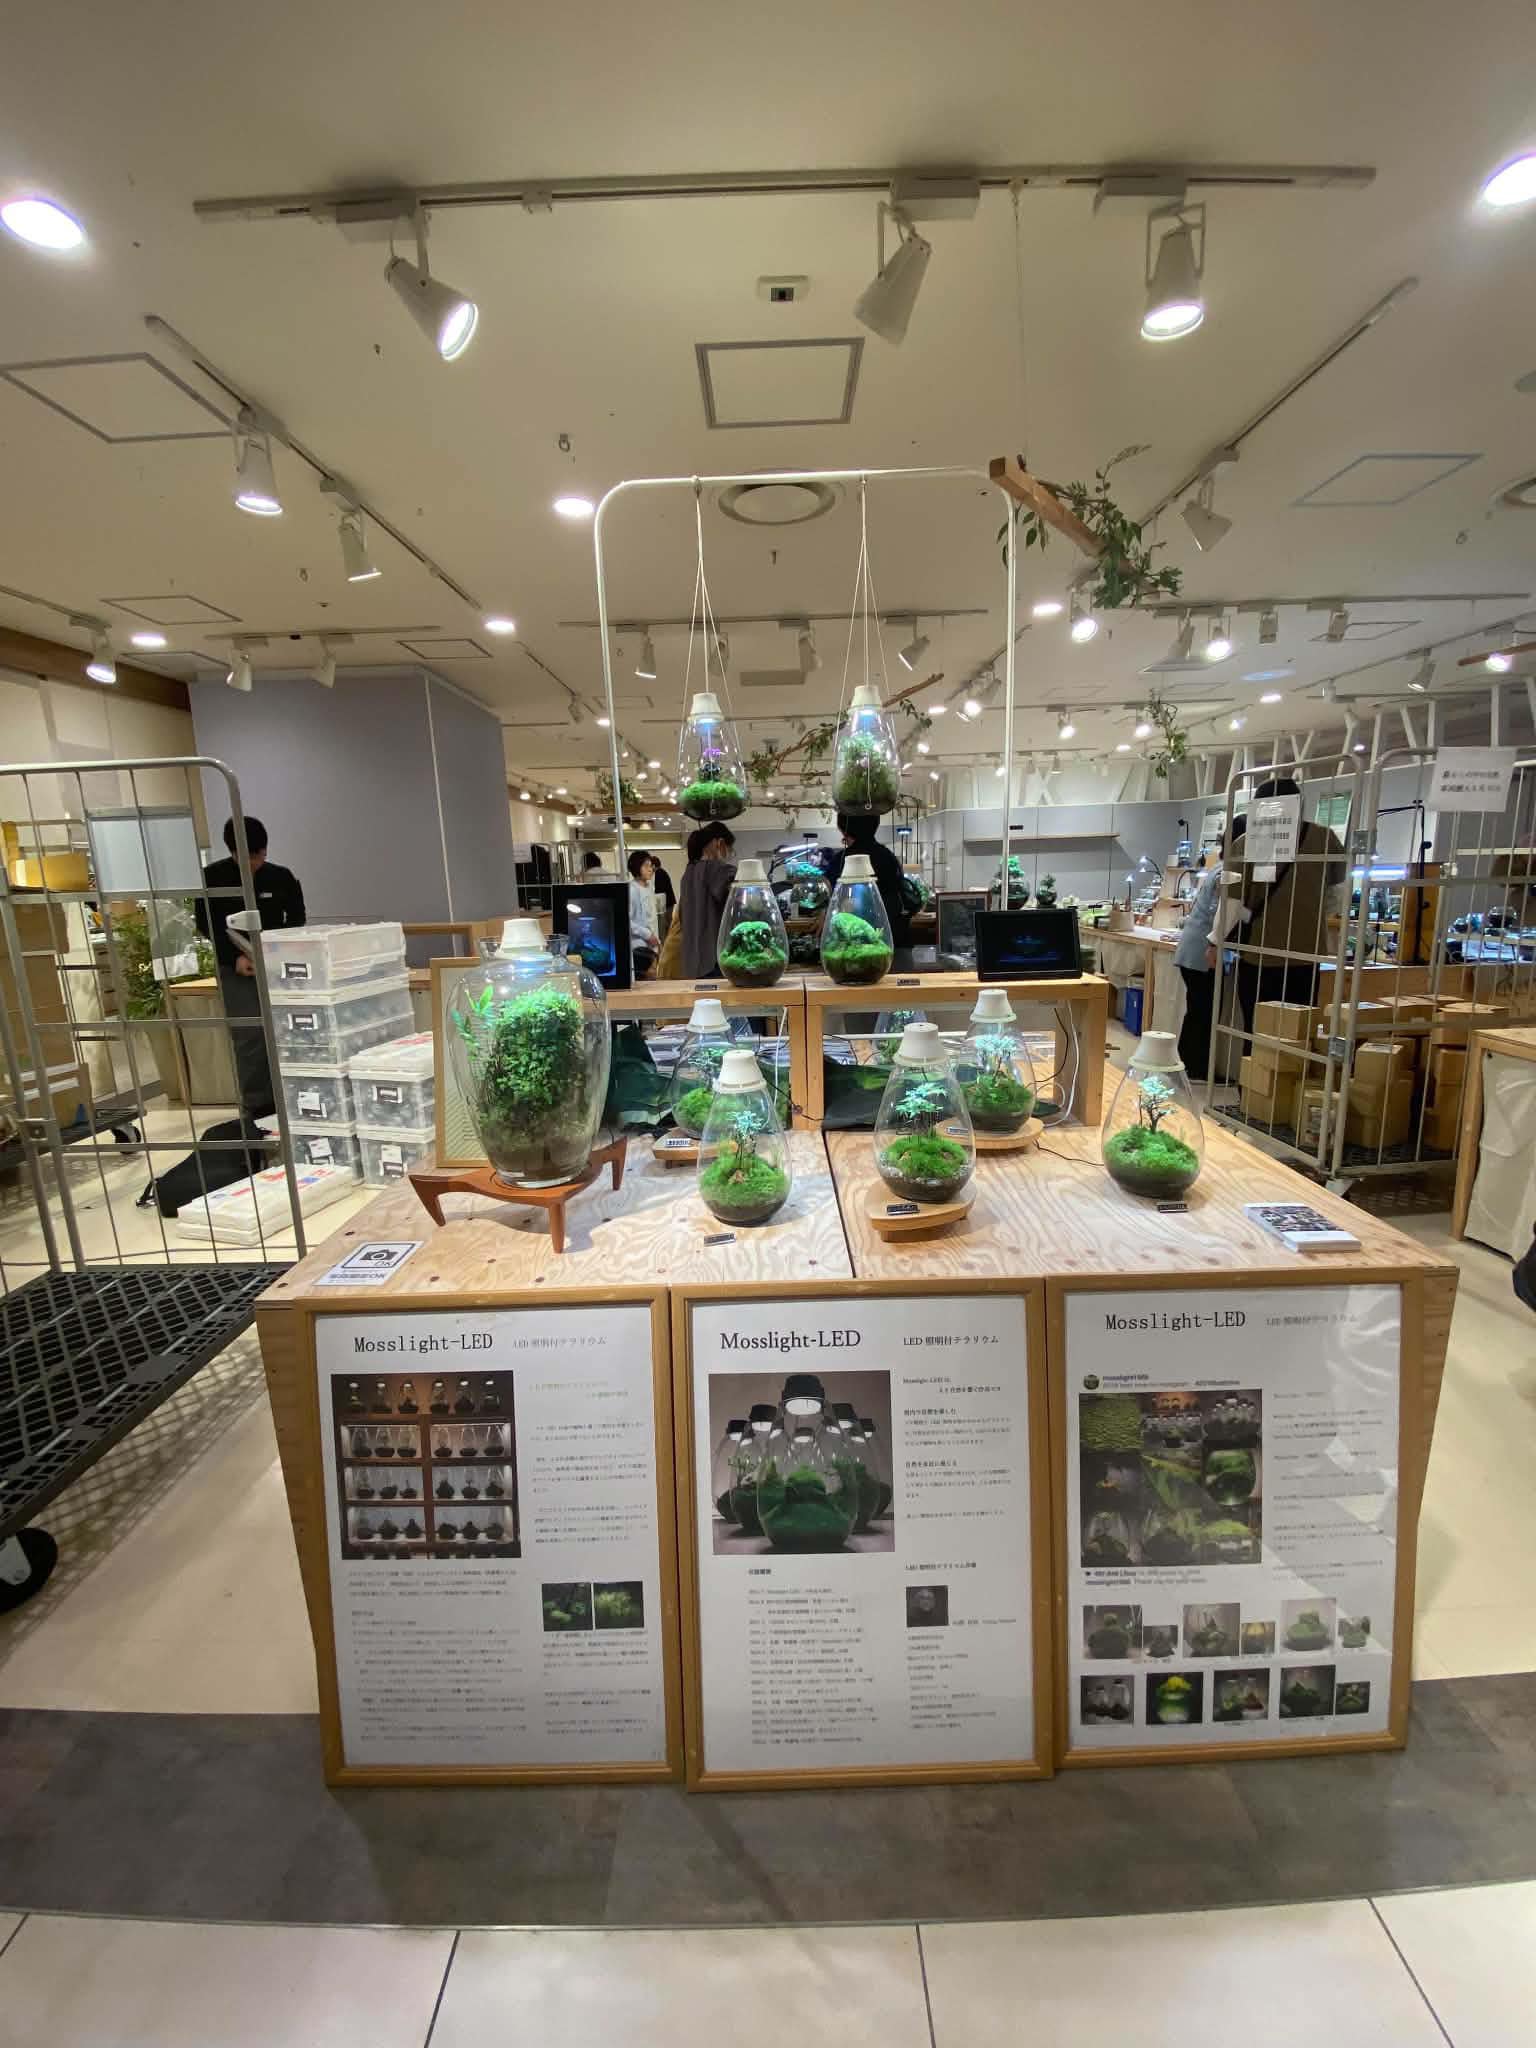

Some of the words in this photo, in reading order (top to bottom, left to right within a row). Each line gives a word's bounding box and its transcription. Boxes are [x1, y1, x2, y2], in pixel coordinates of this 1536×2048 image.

[1105, 1311, 1246, 1331] Mosslight-LED
[354, 1333, 493, 1353] Mosslight-LED
[720, 1329, 861, 1352] Mosslight-LED
[903, 1337, 923, 1346] LED
